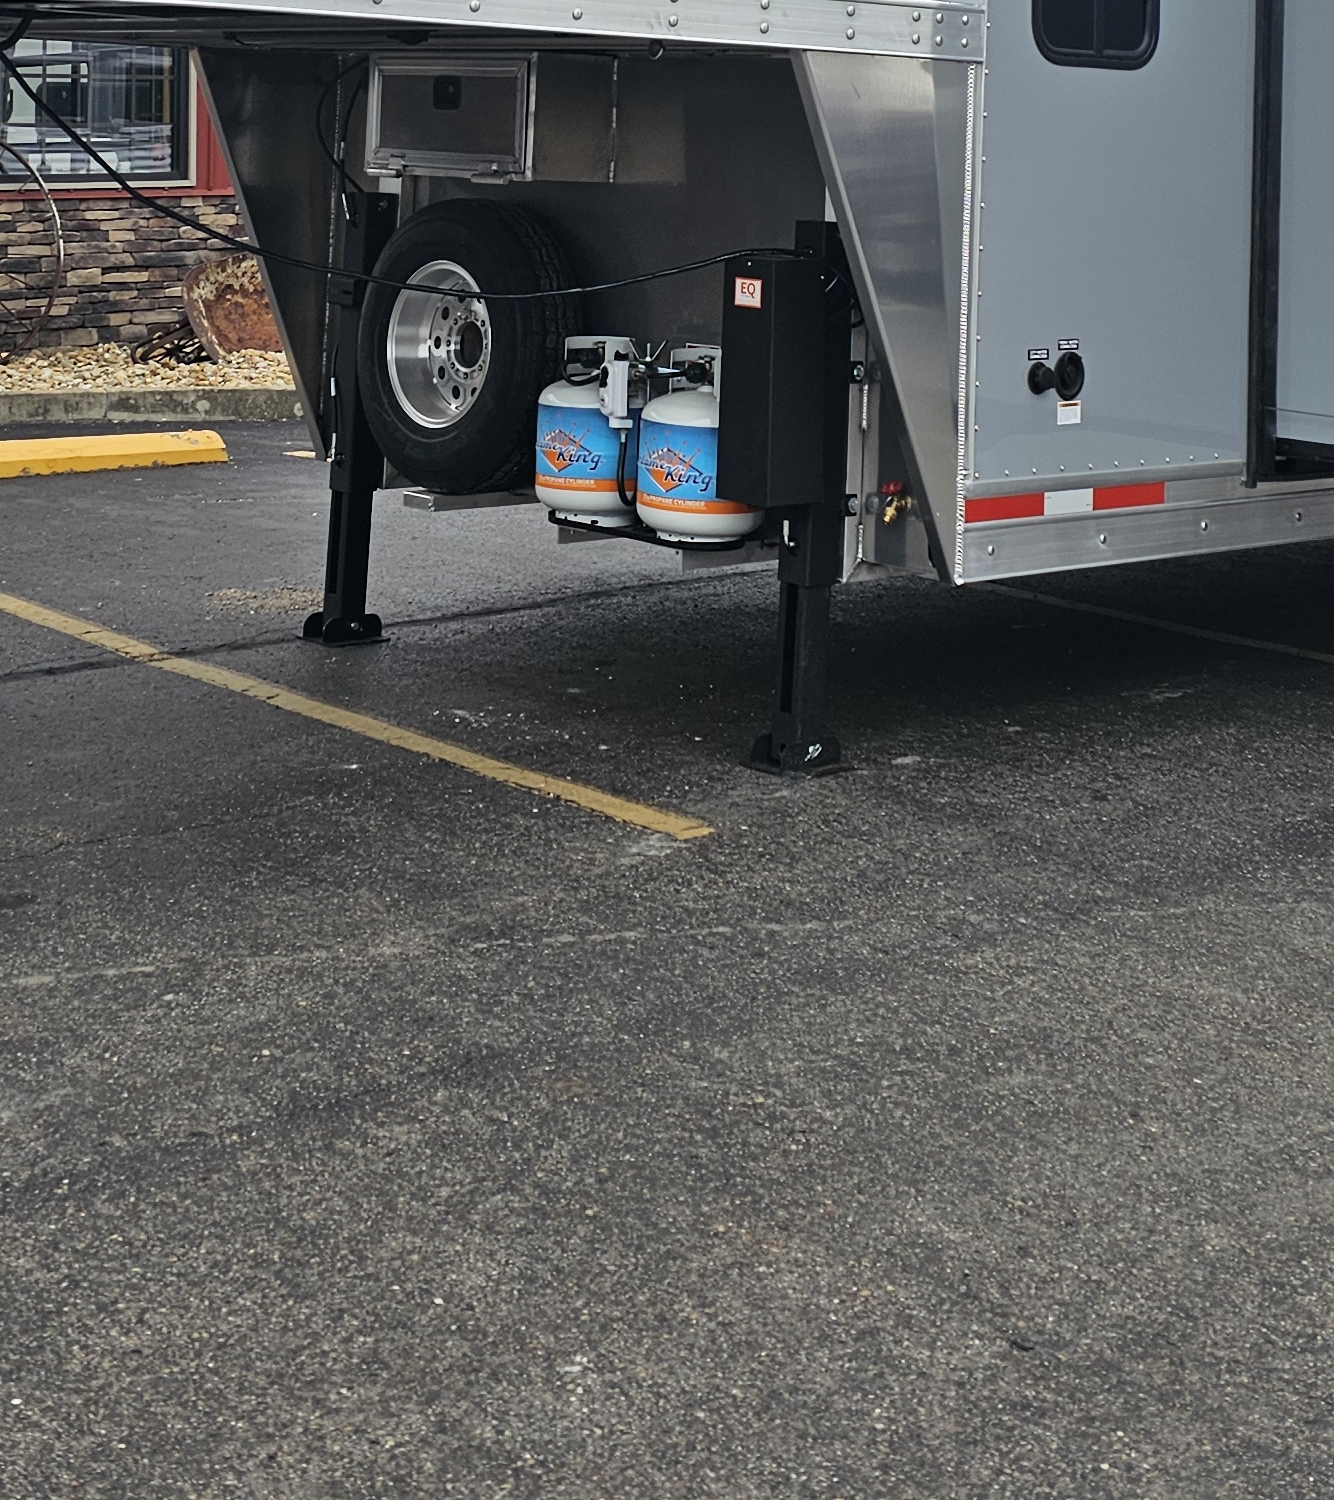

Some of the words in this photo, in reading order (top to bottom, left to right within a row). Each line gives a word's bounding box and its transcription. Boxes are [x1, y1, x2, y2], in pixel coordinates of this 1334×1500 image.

[740, 282, 756, 299] EQ
[555, 444, 603, 471] King
[663, 464, 714, 493] King
